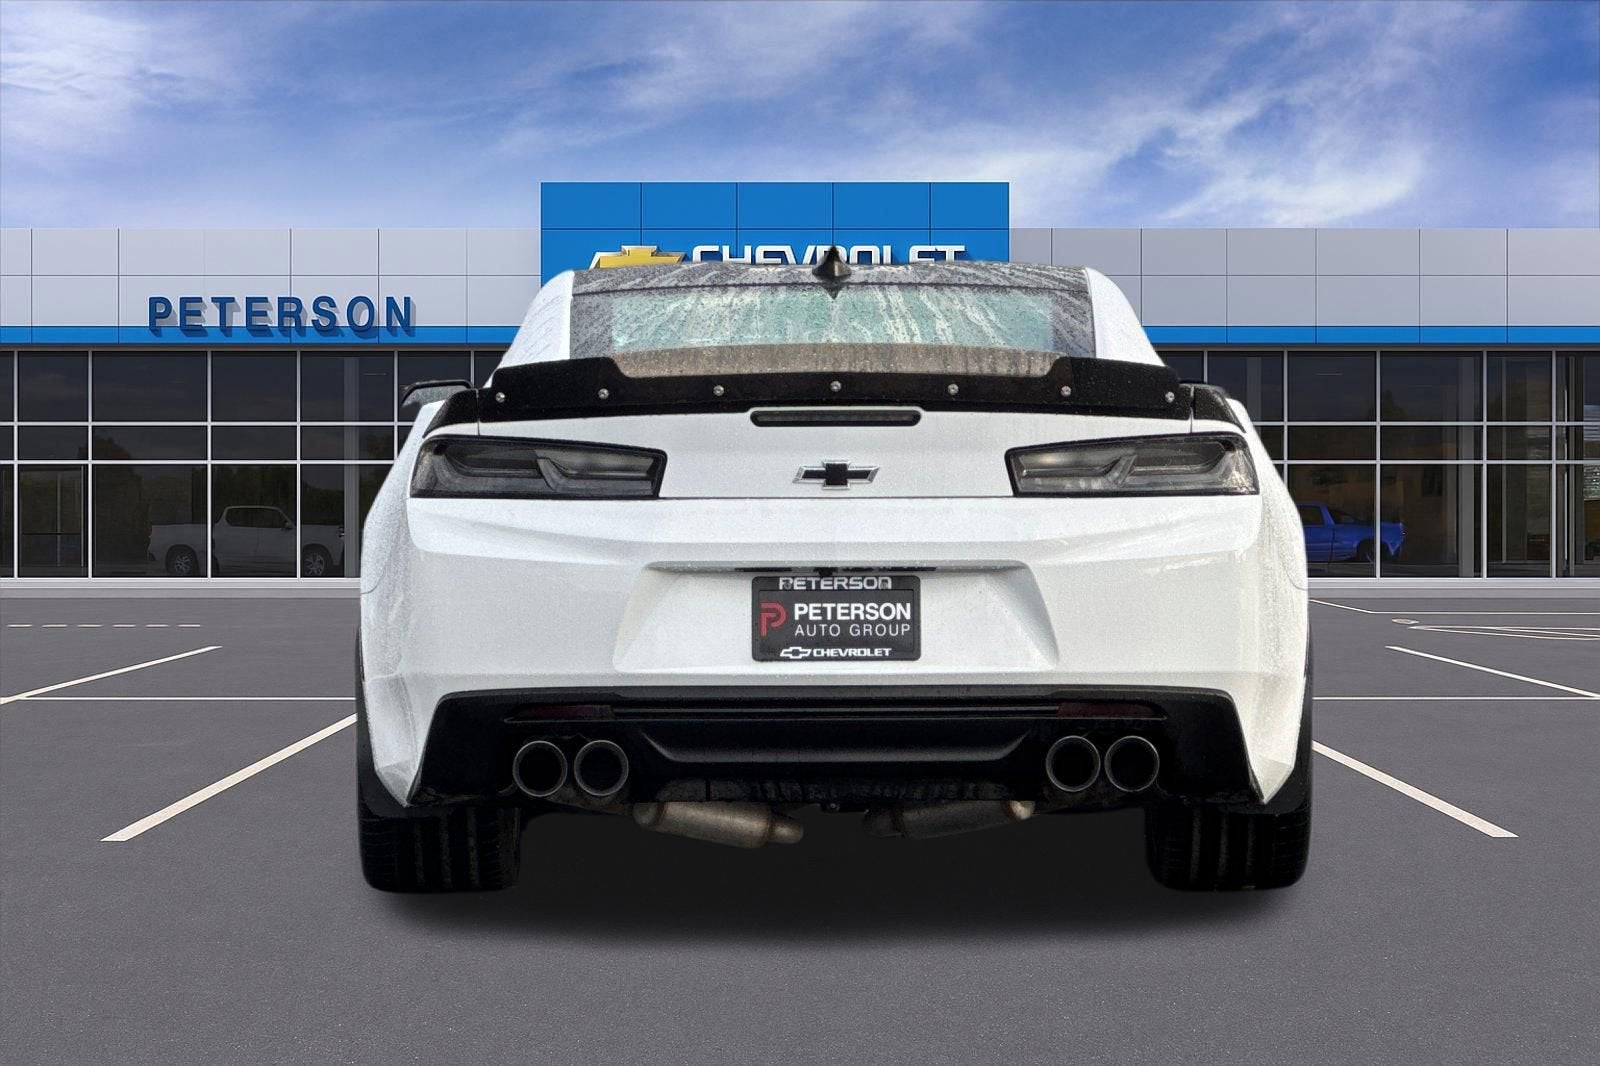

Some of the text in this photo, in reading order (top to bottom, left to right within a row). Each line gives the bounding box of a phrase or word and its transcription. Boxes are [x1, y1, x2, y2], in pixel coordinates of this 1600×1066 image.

[148, 295, 412, 331] PETERSON
[779, 576, 892, 590] PETERSON
[794, 602, 911, 621] PETERSON
[795, 623, 911, 637] AUTO GROUP
[813, 647, 892, 657] CHEVROLET
